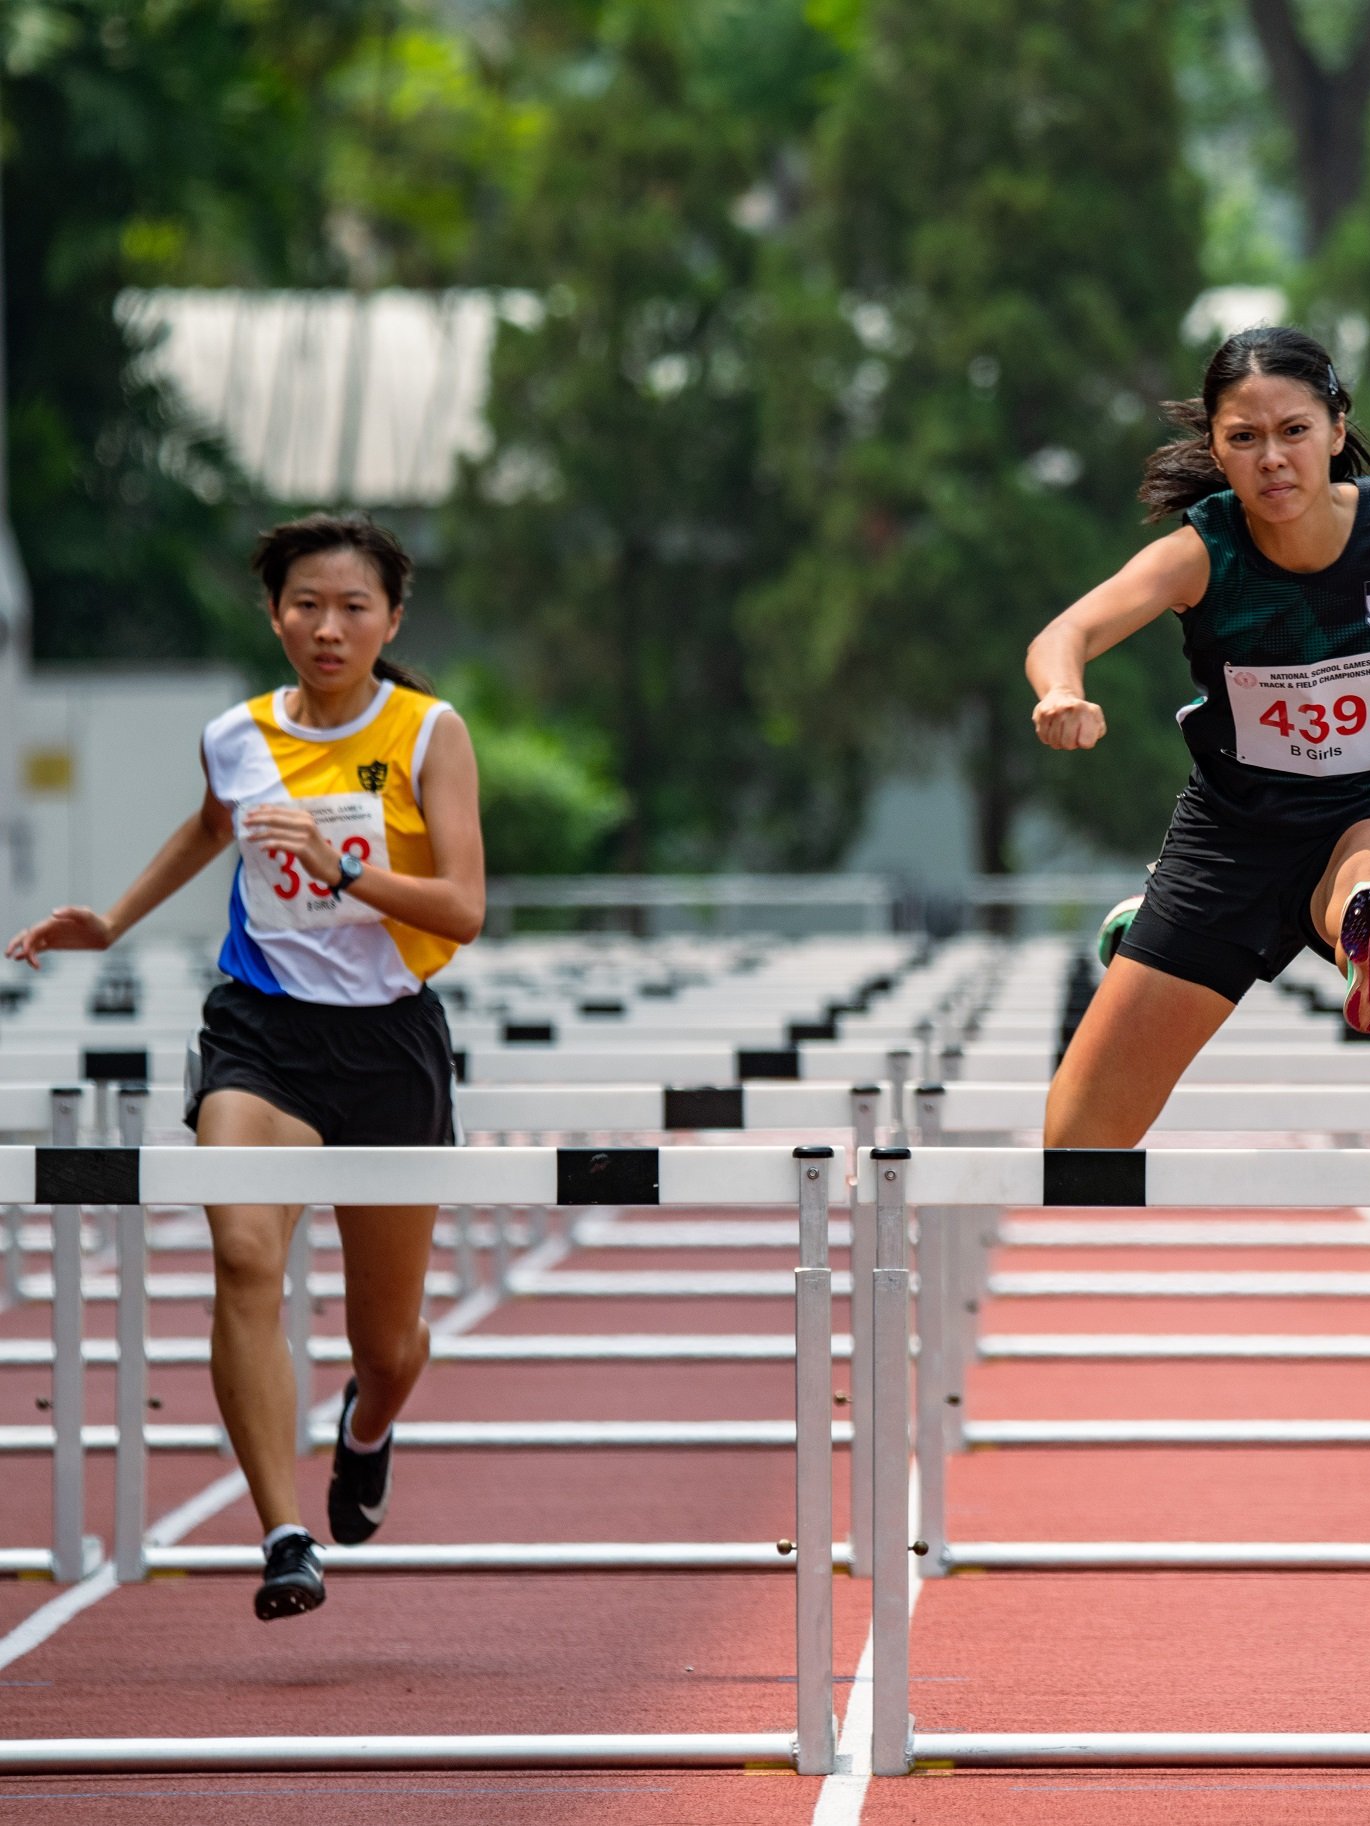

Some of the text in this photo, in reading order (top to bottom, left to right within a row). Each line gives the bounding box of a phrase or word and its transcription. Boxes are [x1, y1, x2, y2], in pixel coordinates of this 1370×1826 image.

[1270, 672, 1310, 681] NATIONAL
[1311, 664, 1341, 678] SCHOOL
[1287, 681, 1294, 689] &
[1295, 680, 1318, 689] FIELD
[1259, 694, 1368, 745] 439
[1290, 744, 1343, 760] B Girls
